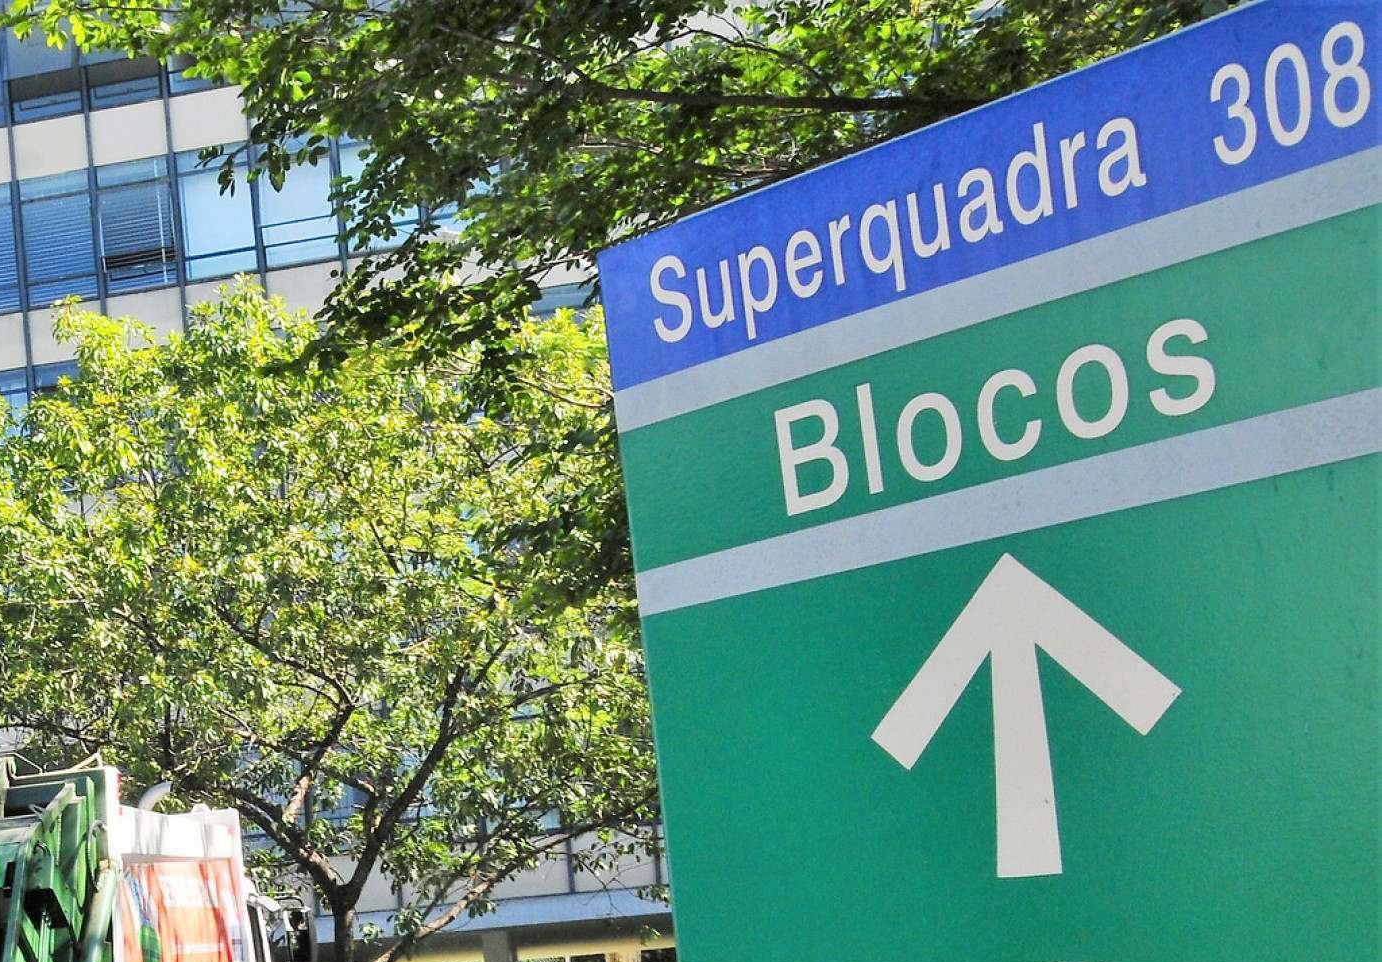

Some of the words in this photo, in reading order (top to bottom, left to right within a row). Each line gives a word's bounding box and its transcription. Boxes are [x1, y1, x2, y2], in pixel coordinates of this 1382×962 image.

[651, 117, 1147, 342] Superquadra
[1211, 21, 1371, 165] 308
[774, 318, 1216, 516] Blocos
